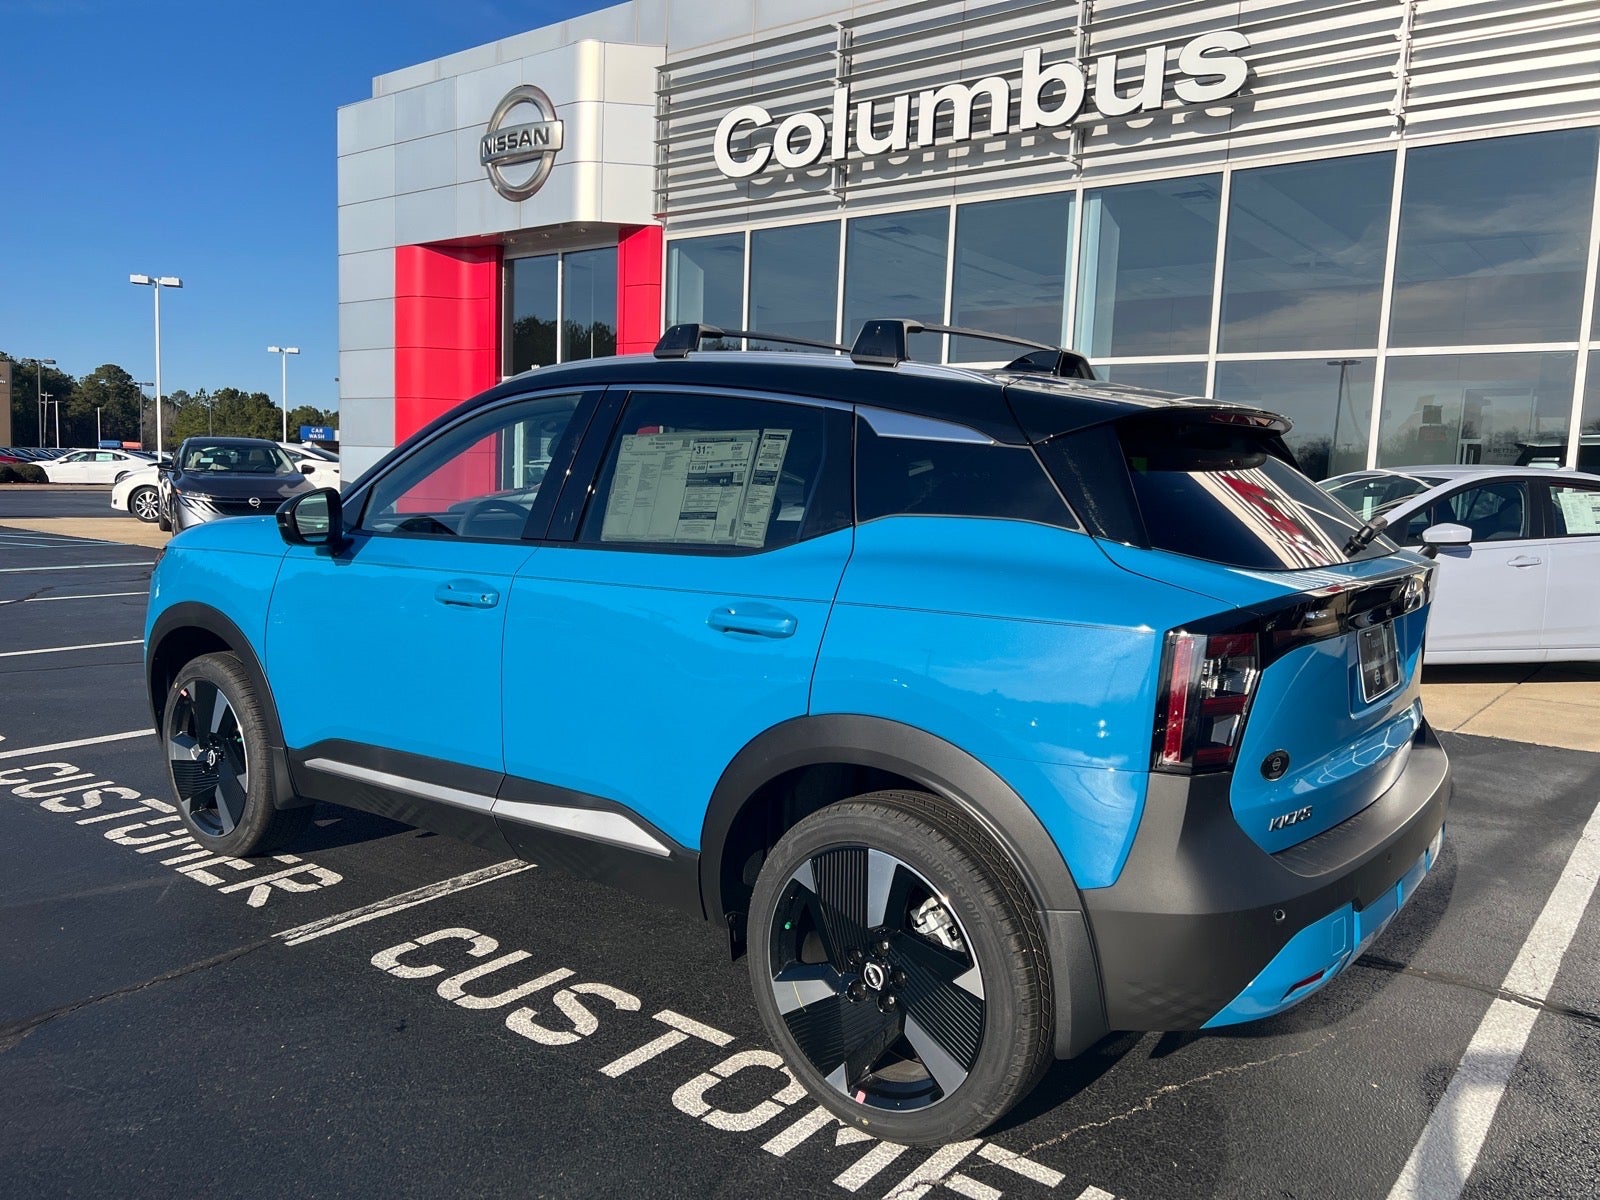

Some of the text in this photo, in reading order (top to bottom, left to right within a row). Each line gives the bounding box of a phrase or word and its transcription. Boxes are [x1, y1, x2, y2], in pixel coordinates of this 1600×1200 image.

[482, 127, 550, 158] NISSAN
[713, 30, 1252, 179] Columbus
[0, 762, 344, 908] CUSTOMER
[1268, 804, 1313, 832] KICKS
[370, 927, 1128, 1200] CUSTOME
